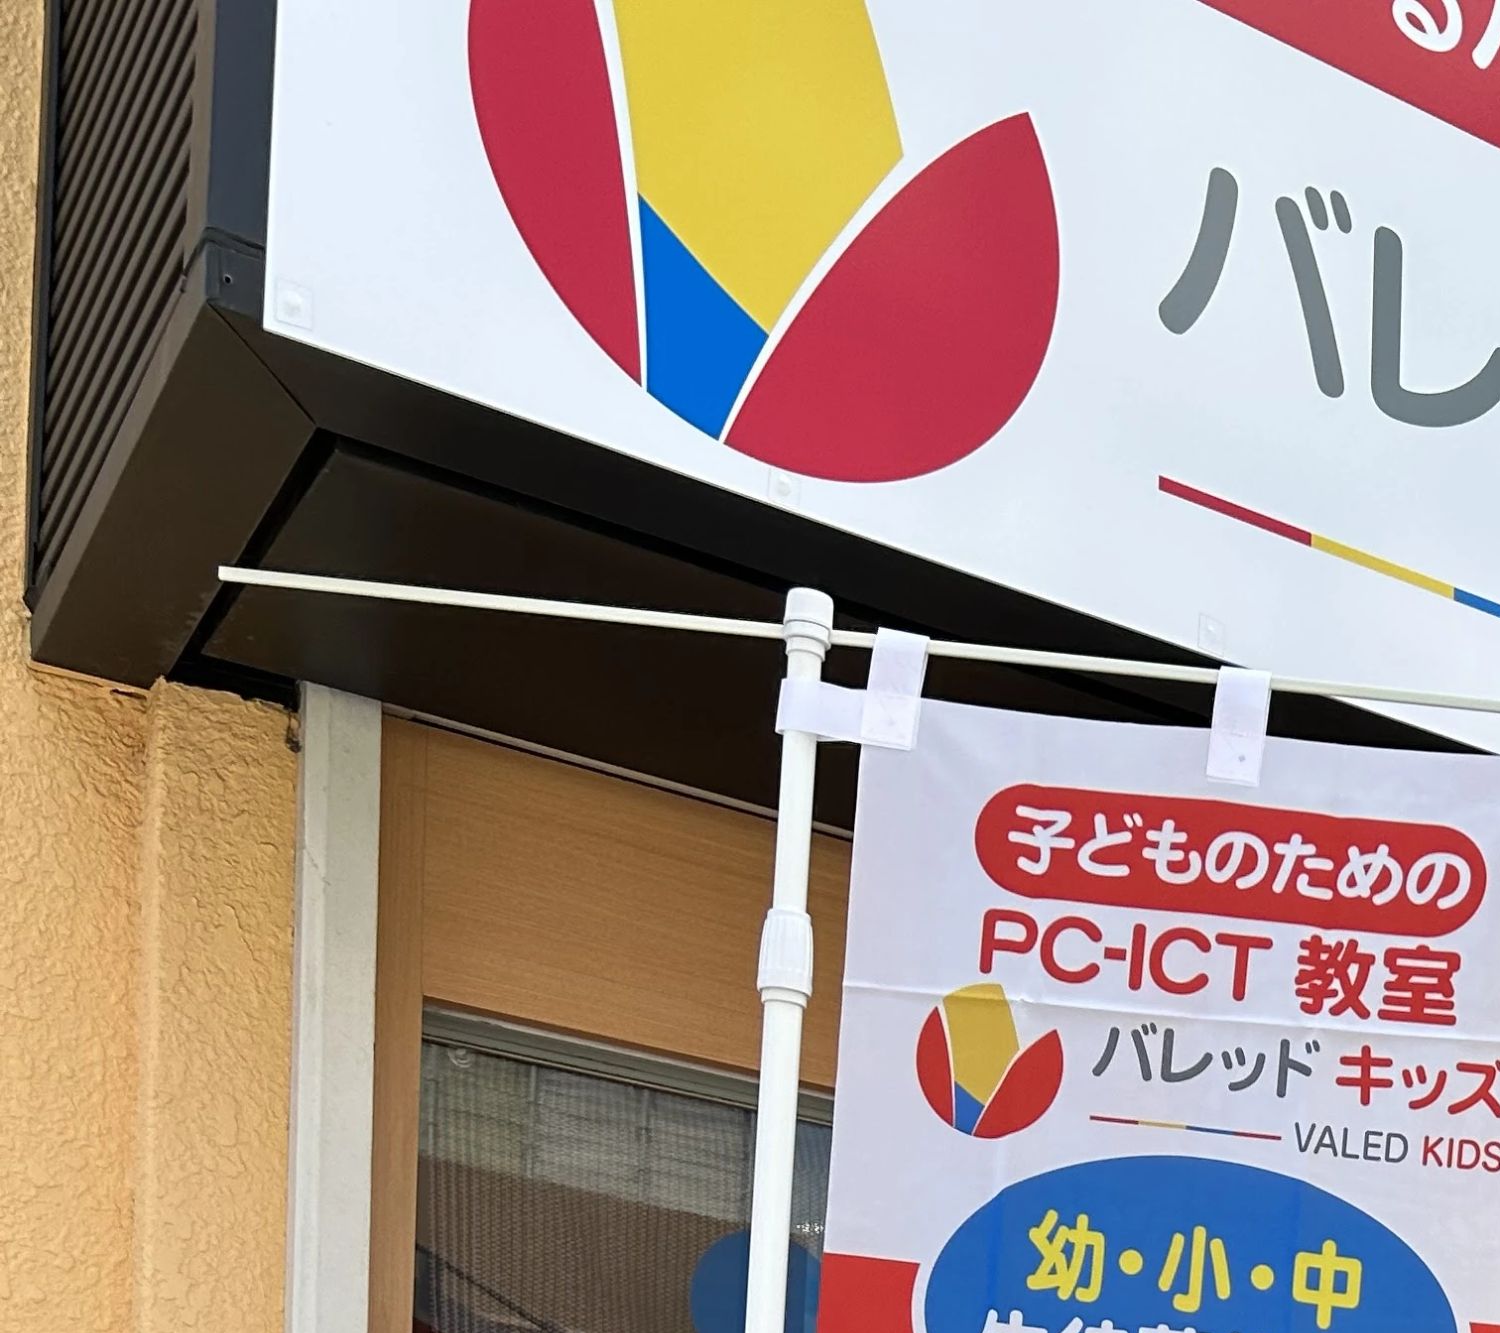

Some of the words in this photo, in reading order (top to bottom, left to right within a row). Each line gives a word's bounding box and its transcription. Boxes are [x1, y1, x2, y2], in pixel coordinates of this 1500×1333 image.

[1007, 804, 1472, 910] 子どものための
[977, 909, 1273, 1002] PC-ICT
[1295, 934, 1462, 1027] 教室
[1091, 1021, 1321, 1099] バレッド
[1293, 1121, 1409, 1164] VALED
[1026, 1208, 1363, 1330] 幼・小・中
